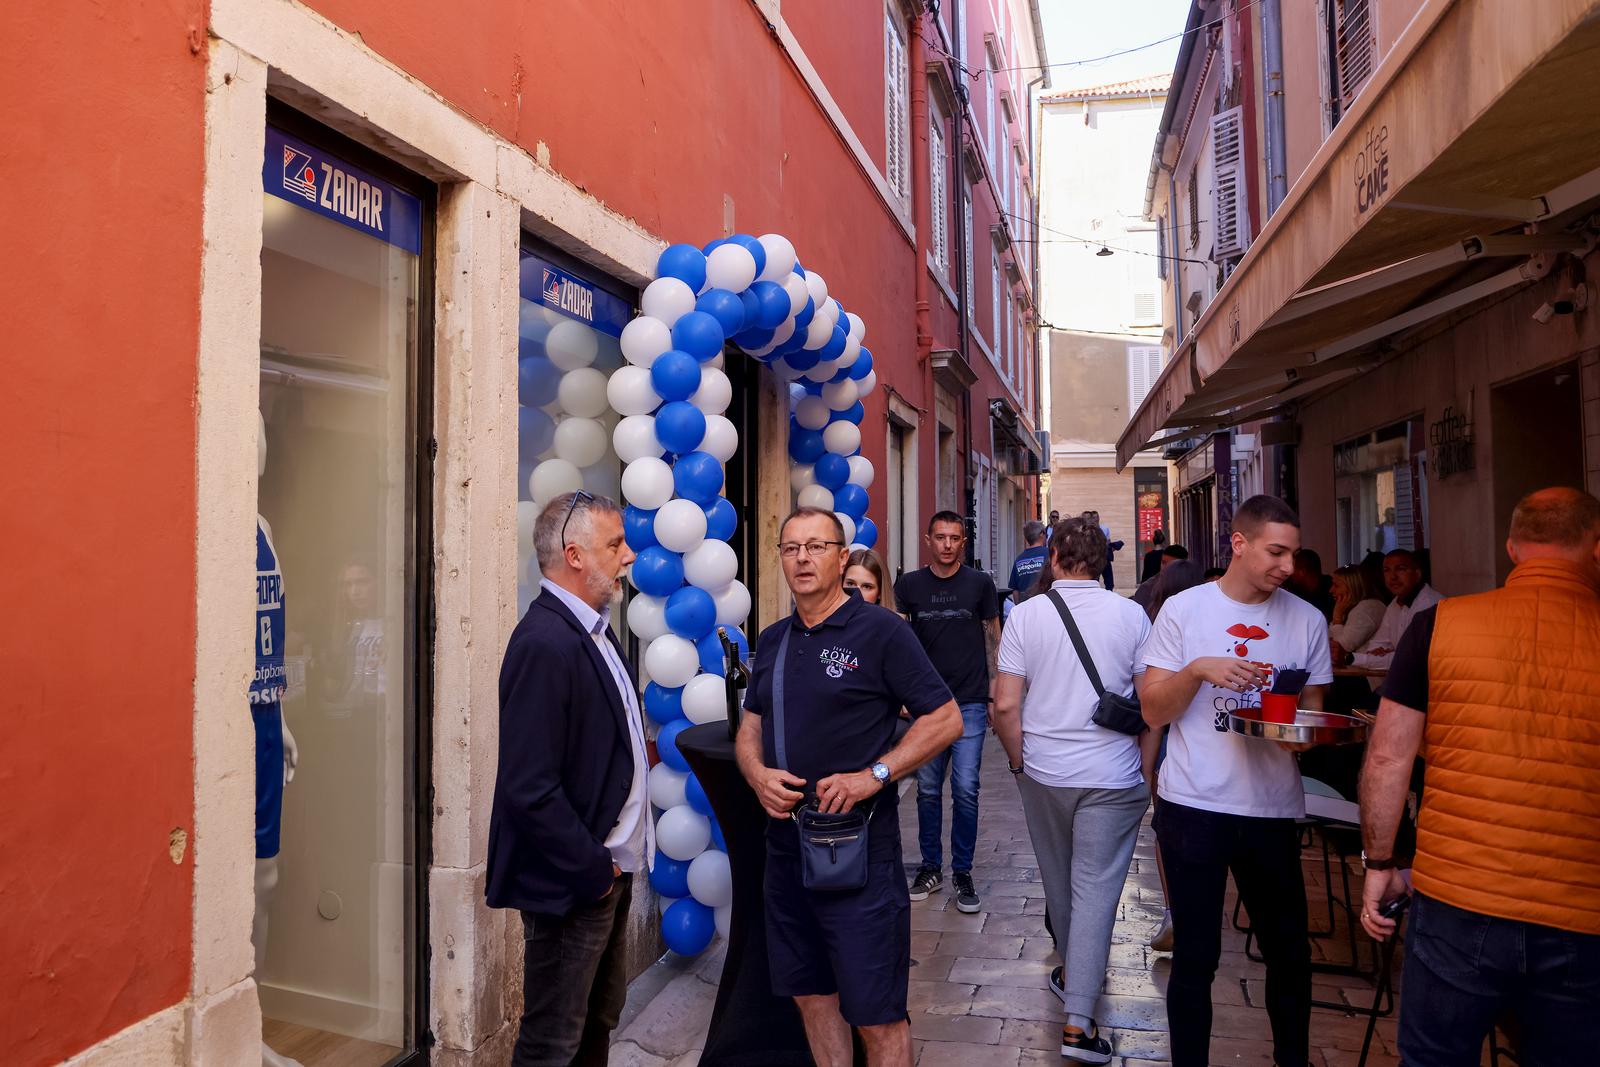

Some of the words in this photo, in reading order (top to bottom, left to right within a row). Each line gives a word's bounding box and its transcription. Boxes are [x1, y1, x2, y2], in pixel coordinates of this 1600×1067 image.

[1354, 125, 1389, 187] coffee
[1358, 154, 1389, 214] CAKE
[320, 161, 383, 232] ZADAR
[561, 276, 593, 322] ZADAR
[819, 648, 859, 667] ROMA
